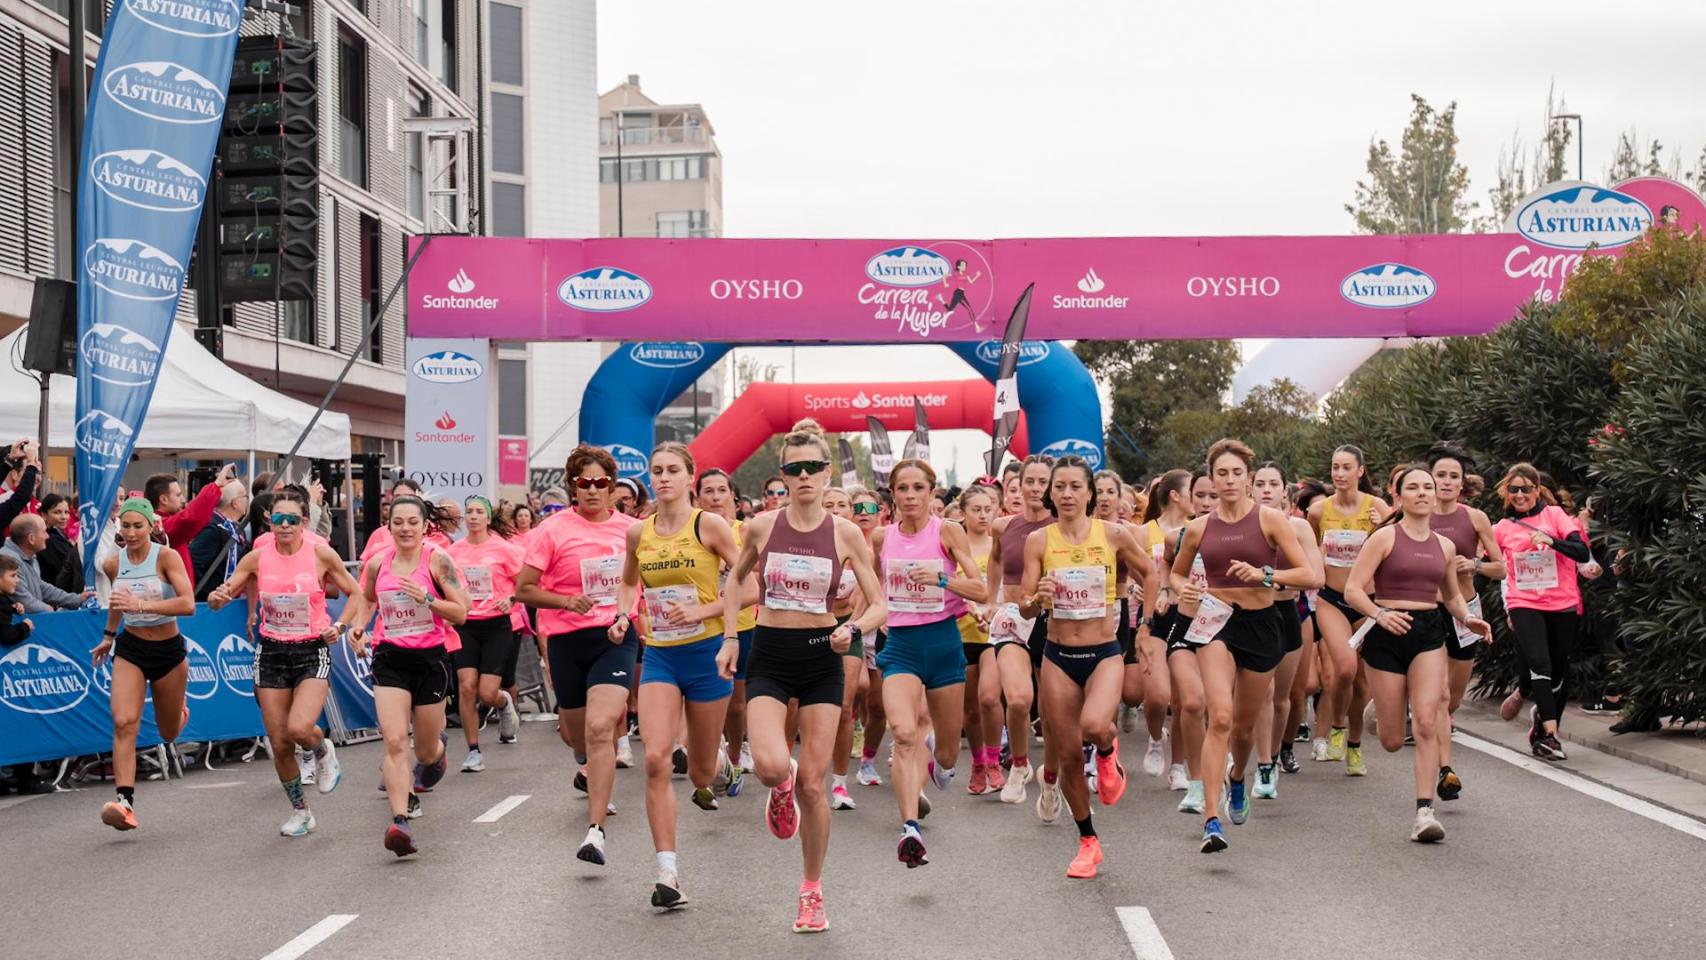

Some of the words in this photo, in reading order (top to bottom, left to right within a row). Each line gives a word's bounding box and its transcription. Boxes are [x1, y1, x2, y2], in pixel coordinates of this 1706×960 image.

[112, 73, 216, 116] ASTURIANA
[98, 161, 199, 204] ASTURIANA
[1528, 209, 1642, 233] ASTURIANA
[874, 261, 944, 276] ASTURIANA
[1505, 245, 1617, 278] Carr
[566, 283, 645, 300] ASTURIANA
[709, 279, 804, 300] OYSHO
[858, 283, 929, 304] Carrera
[1187, 276, 1281, 297] OYSHO
[1348, 280, 1428, 296] ASTURIANA
[423, 294, 499, 309] Santander
[1053, 294, 1128, 309] Santander
[875, 305, 889, 319] de
[891, 306, 901, 319] la
[898, 302, 954, 337] Mujer
[636, 345, 699, 359] ASTURIANA
[417, 361, 478, 376] ASTURIANA
[804, 394, 850, 411] Sports
[415, 431, 476, 443] Santander
[410, 471, 483, 487] OYSHO
[788, 546, 815, 555] OYSHO
[785, 581, 810, 591] 016
[905, 582, 926, 592] 016
[1066, 589, 1088, 600] 016
[275, 611, 295, 619] 016
[397, 609, 416, 618] 016
[3, 672, 85, 698] ASTURIANA
